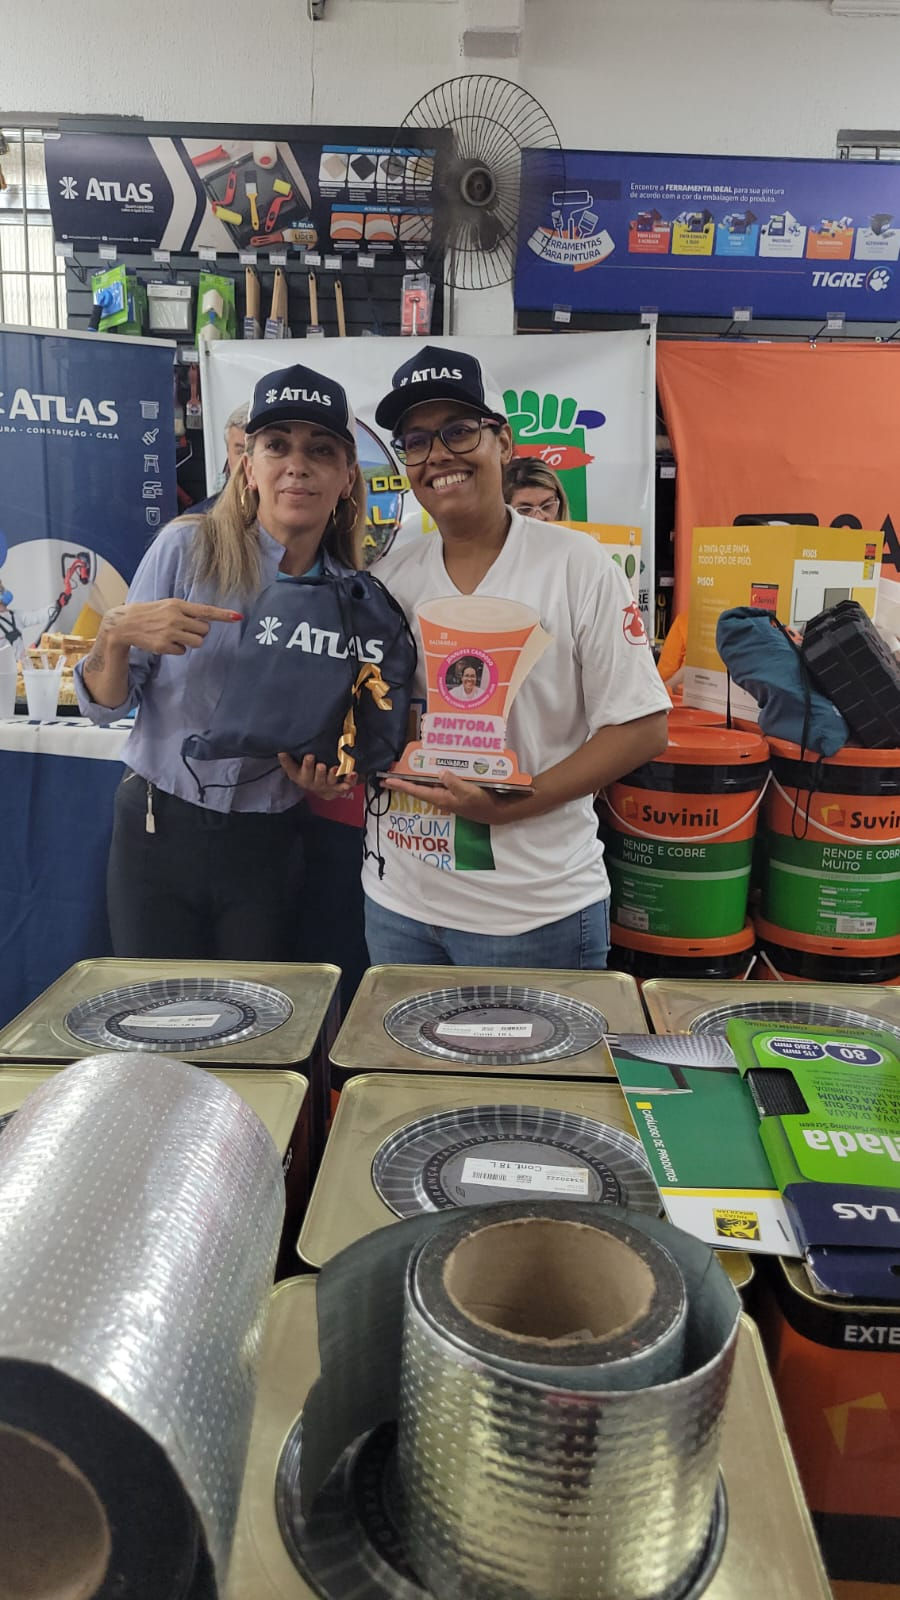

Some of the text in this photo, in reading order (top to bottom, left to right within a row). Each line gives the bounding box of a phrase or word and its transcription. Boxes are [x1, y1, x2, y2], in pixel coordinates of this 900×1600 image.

[86, 177, 153, 202] ATLAS
[631, 183, 659, 191] Encontre
[665, 183, 712, 192] FERRAMENTA
[713, 185, 733, 193] IDEAL
[733, 187, 749, 195] para
[761, 187, 784, 196] pintura
[702, 193, 739, 203] embalagem
[541, 235, 602, 251] FERRAMENTAS
[543, 247, 601, 262] PARA PINTURA
[812, 271, 866, 288] TIGRE
[411, 367, 463, 384] ATLAS
[280, 387, 332, 406] ATLAS
[9, 388, 119, 426] ATLAS
[26, 427, 86, 438] CONSTRUÇÃO
[96, 432, 119, 440] CASA
[703, 544, 718, 553] TINTA
[720, 544, 732, 555] QUE
[286, 622, 384, 664] ATLAS
[433, 716, 495, 733] PINTORA
[427, 733, 501, 750] DESTAQUE
[437, 758, 469, 768] SALVABRAS
[642, 804, 719, 827] Suvinil
[390, 815, 450, 837] POR UM
[387, 829, 449, 852] PINTOR
[623, 838, 706, 858] RENDE E COBRE
[622, 850, 652, 865] MUITO
[823, 847, 863, 860] RENDE
[866, 850, 873, 860] E
[821, 858, 860, 871] MUITO
[782, 1048, 801, 1056] mm
[840, 1047, 867, 1061] 80
[817, 1093, 860, 1103] COMUM
[642, 1109, 678, 1182] CATÁLOGO DE PRODUTOS
[803, 1130, 900, 1162] lada
[498, 1162, 510, 1170] 18
